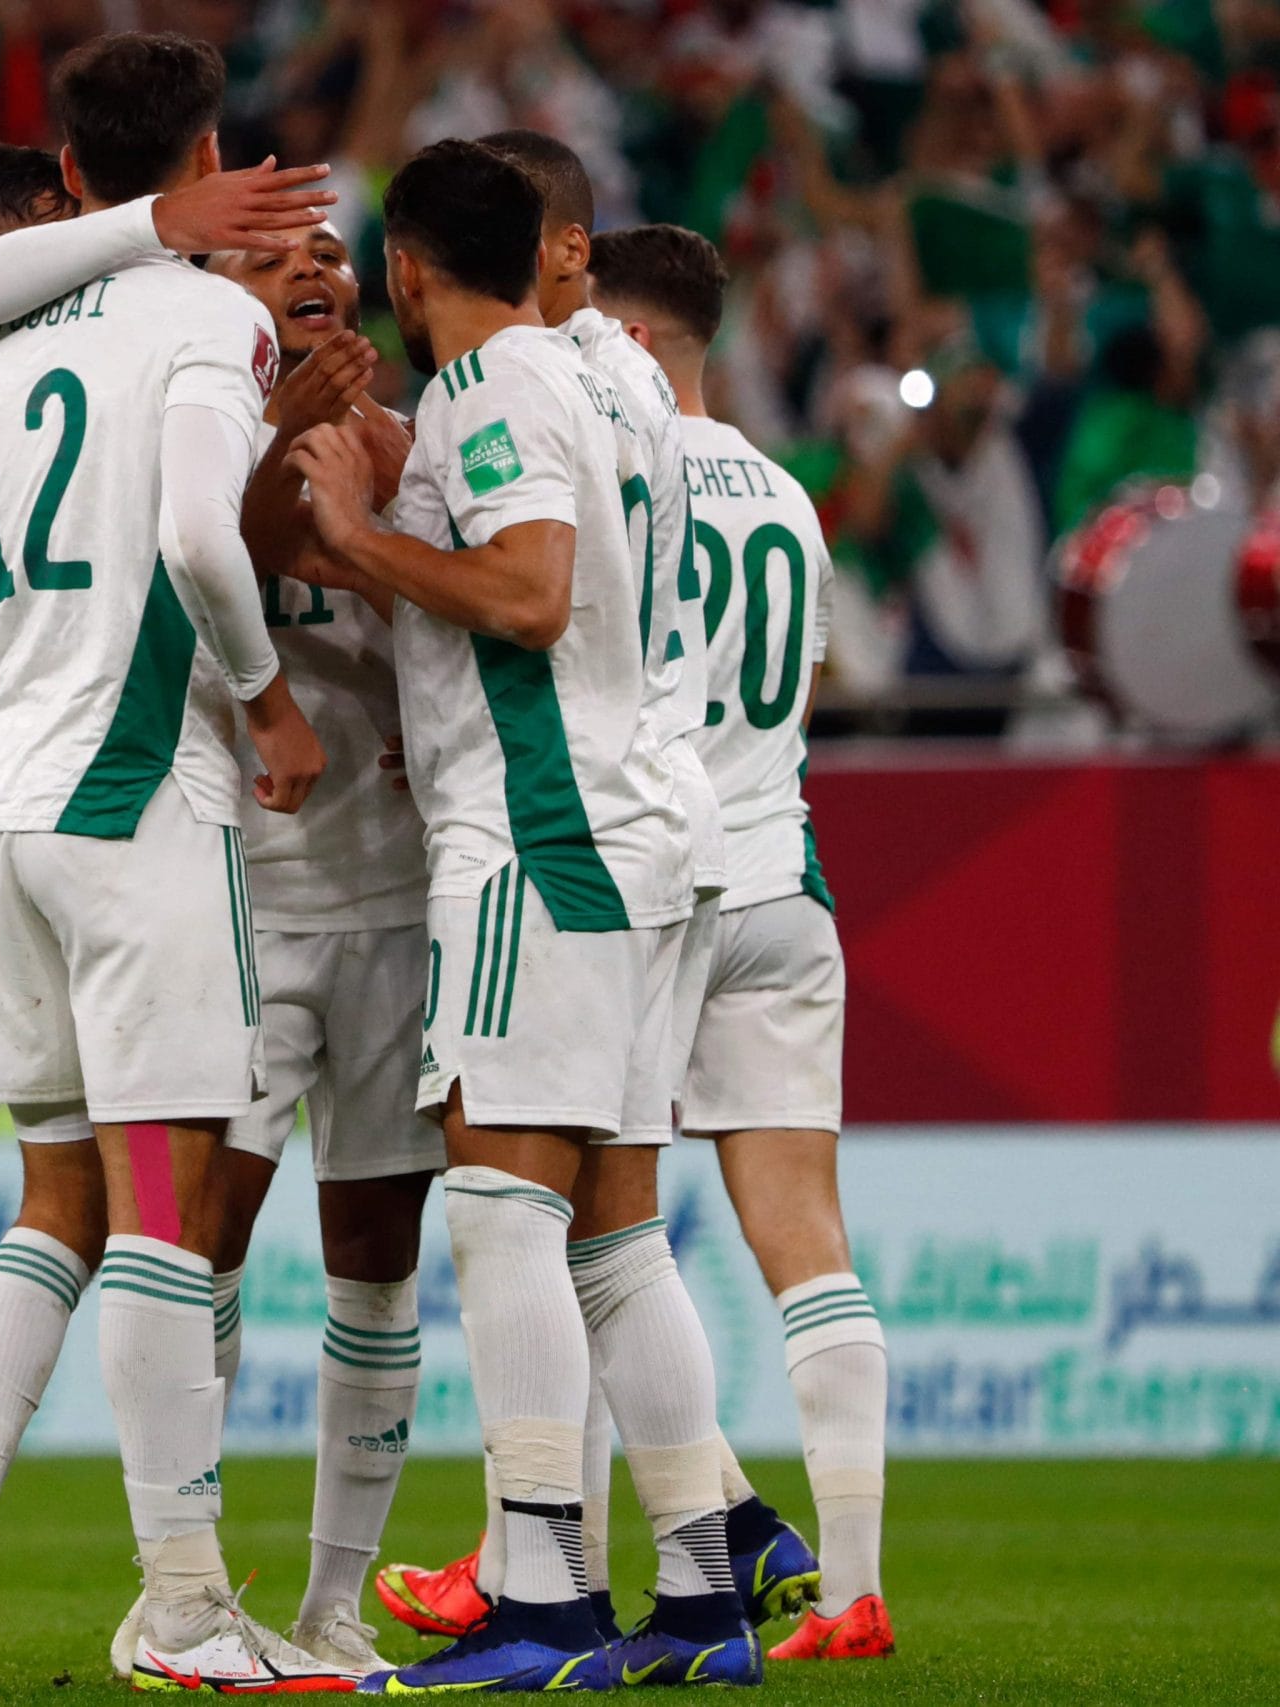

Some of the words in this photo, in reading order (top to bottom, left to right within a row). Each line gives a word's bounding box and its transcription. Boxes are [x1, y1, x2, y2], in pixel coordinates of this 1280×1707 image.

[492, 456, 515, 471] FIFA
[684, 455, 777, 498] CHETI
[694, 519, 806, 731] 20
